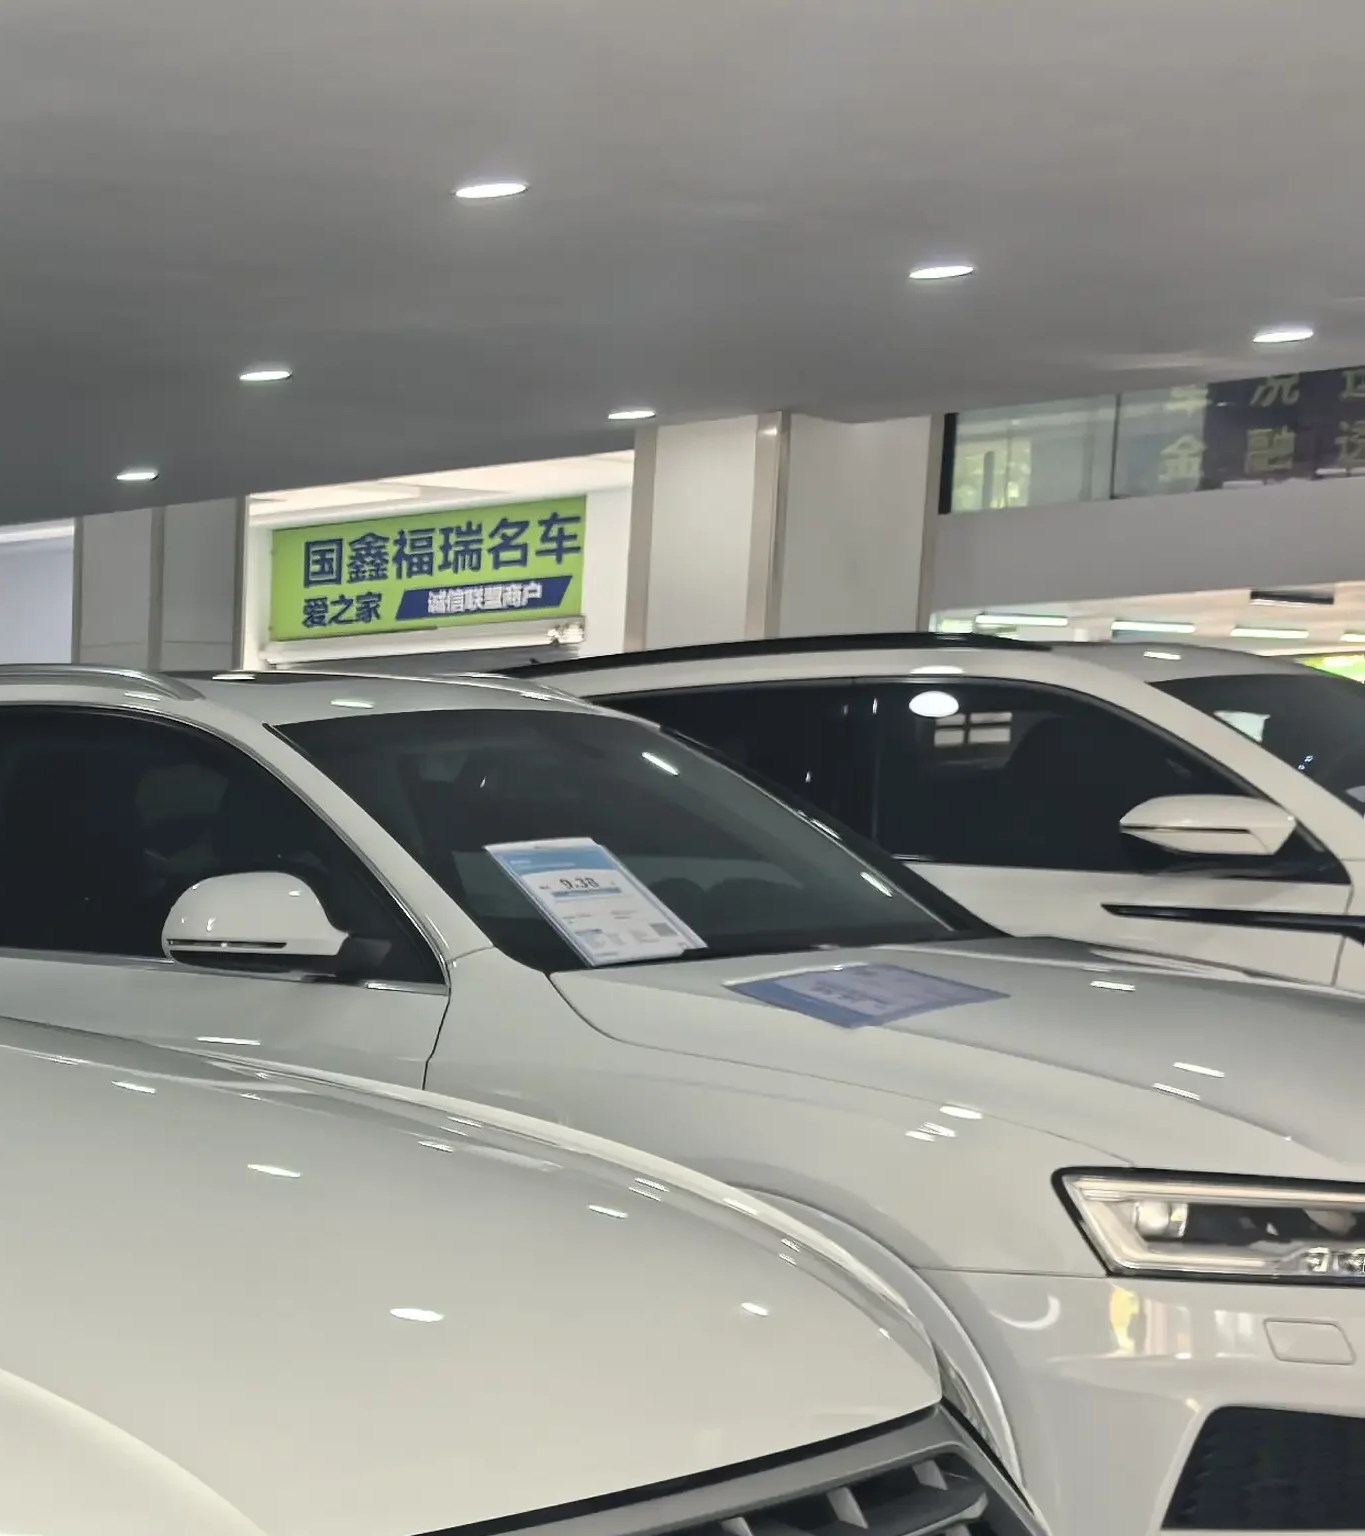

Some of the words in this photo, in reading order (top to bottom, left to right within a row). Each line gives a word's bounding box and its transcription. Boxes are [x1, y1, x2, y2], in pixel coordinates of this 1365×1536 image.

[303, 512, 582, 588] 国鑫福瑞名车
[302, 592, 382, 628] 爱之家
